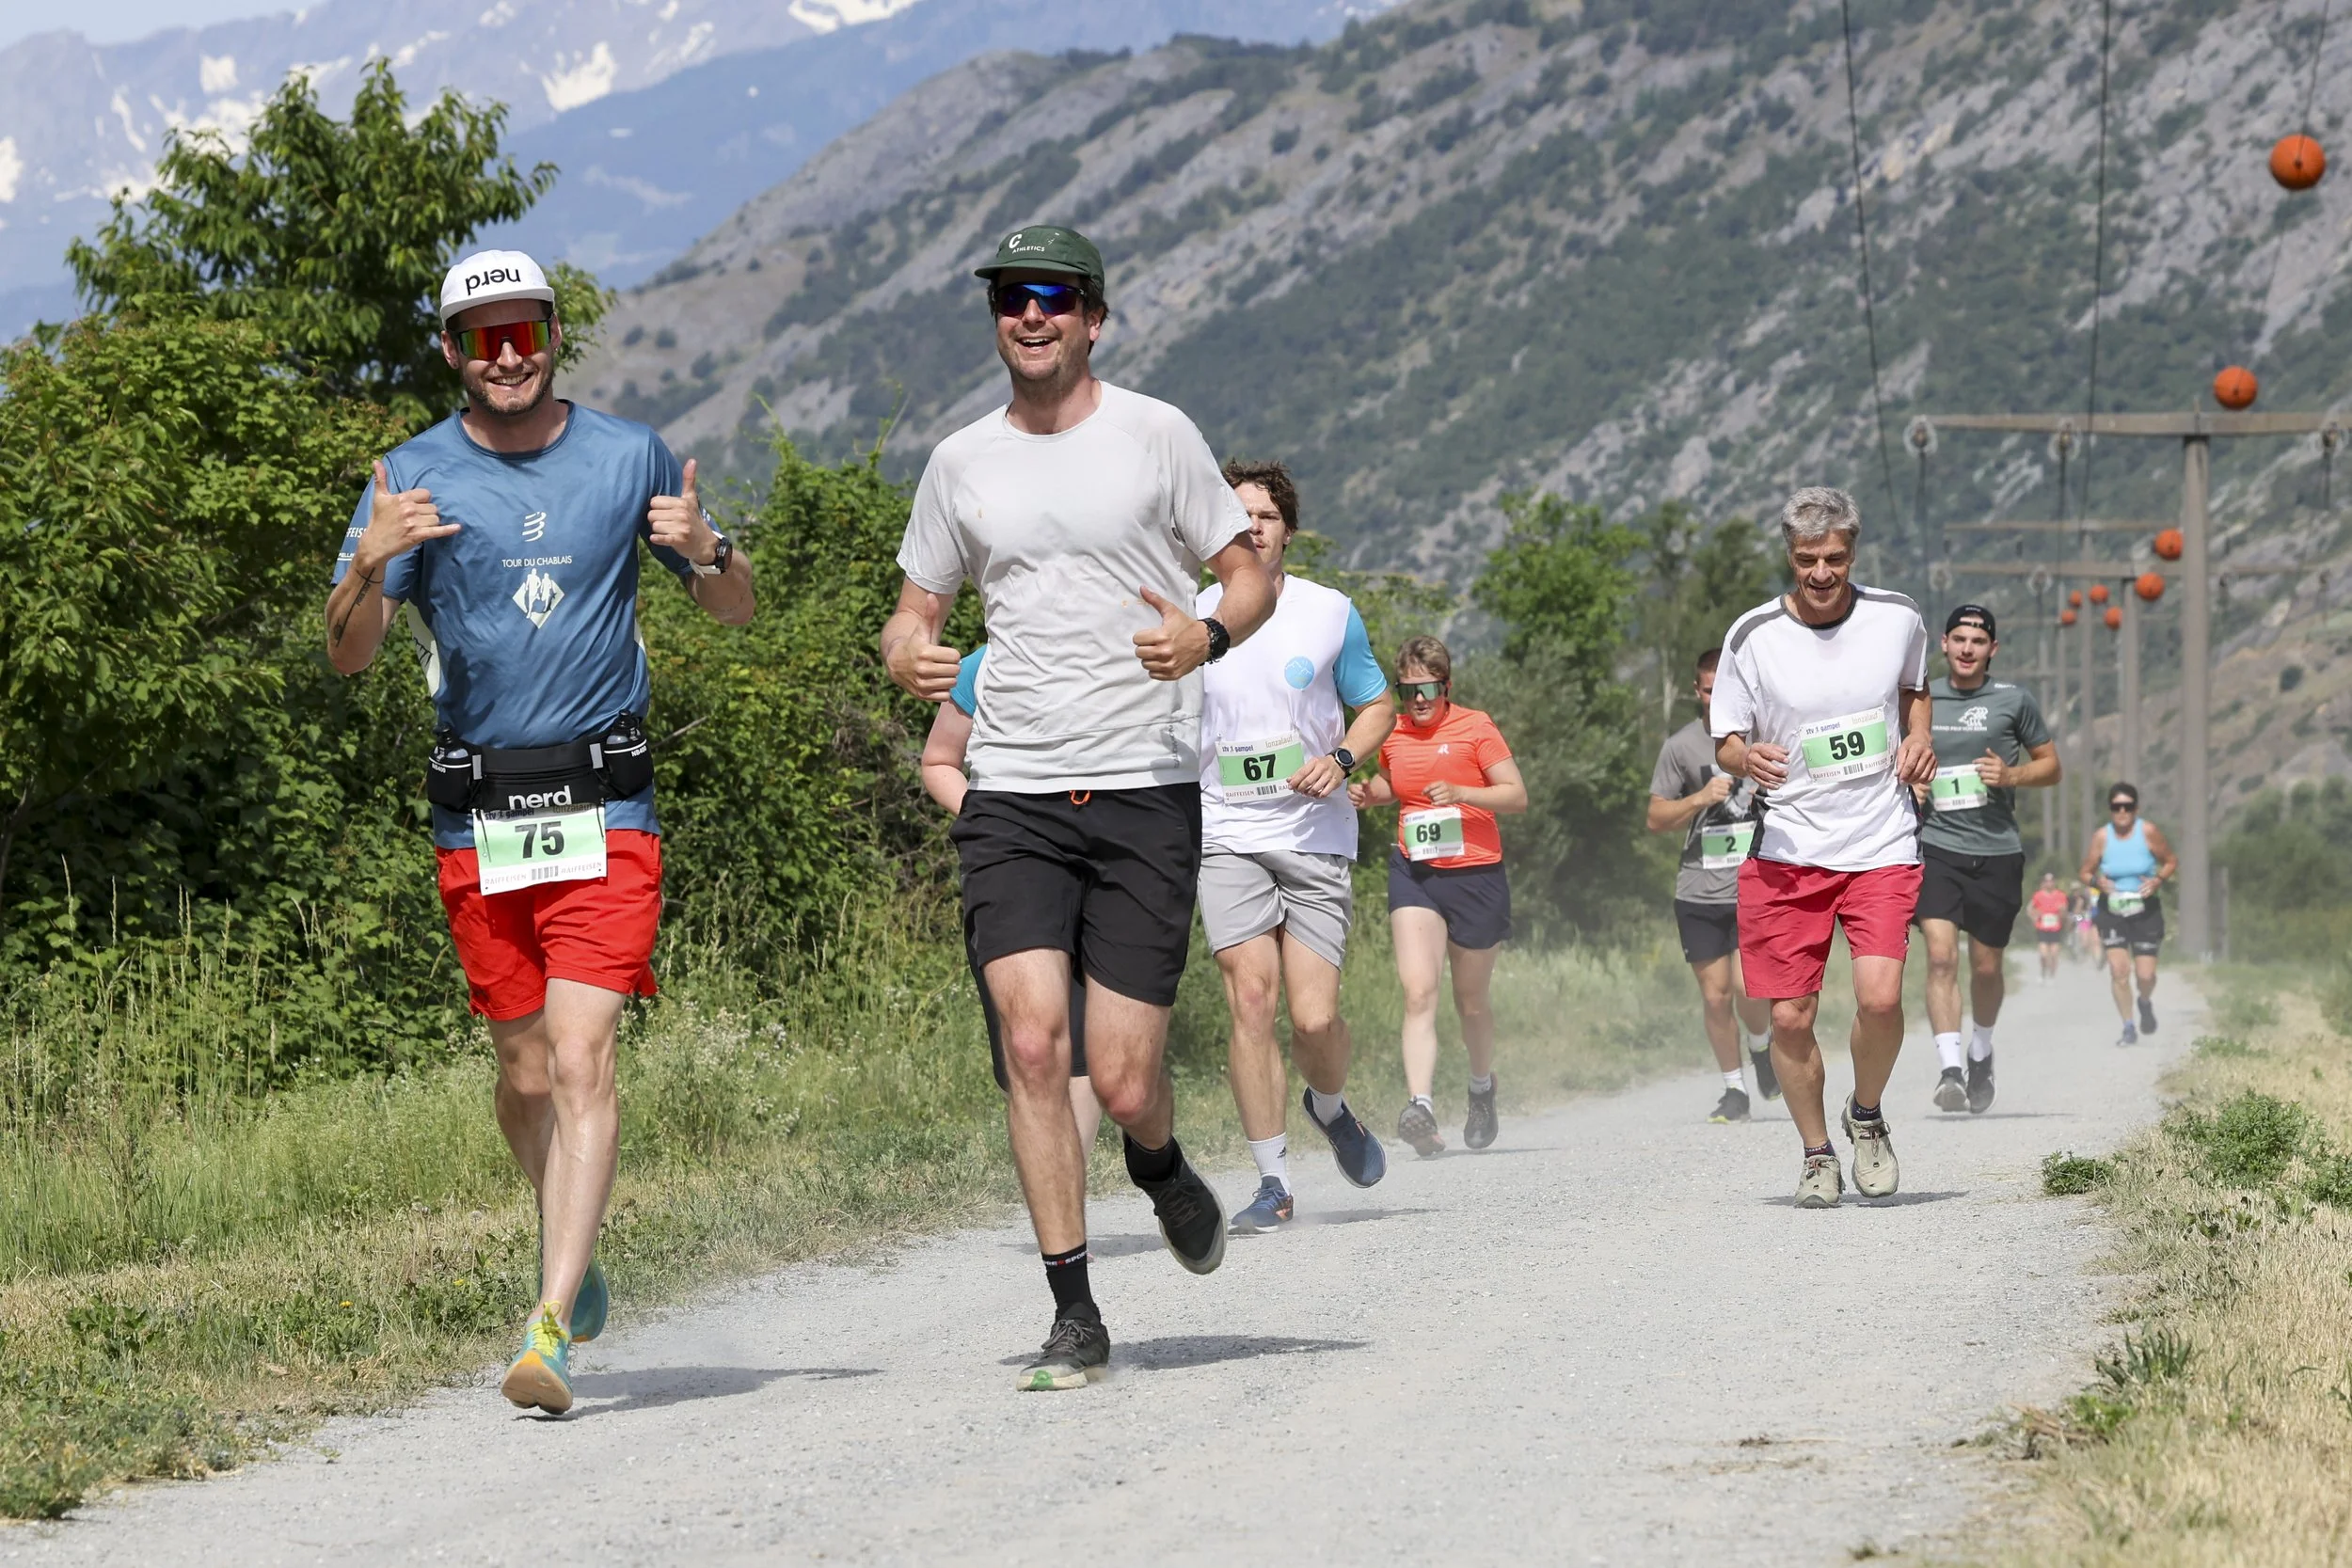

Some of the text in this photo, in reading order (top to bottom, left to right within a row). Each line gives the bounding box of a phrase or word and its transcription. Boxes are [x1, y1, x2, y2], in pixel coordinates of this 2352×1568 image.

[1011, 245, 1045, 254] ATHLETICS
[465, 268, 521, 296] nerd
[501, 555, 572, 567] TOUR DU CHABLAIS
[1829, 731, 1866, 760] 59
[1243, 753, 1276, 781] 67
[1951, 778, 1960, 794] 1
[508, 784, 572, 810] nerd
[515, 820, 564, 859] 75
[1416, 823, 1441, 843] 69
[1724, 836, 1738, 853] 2
[561, 862, 602, 874] RAIFFEISEN
[485, 875, 527, 885] RAIFFEISEN
